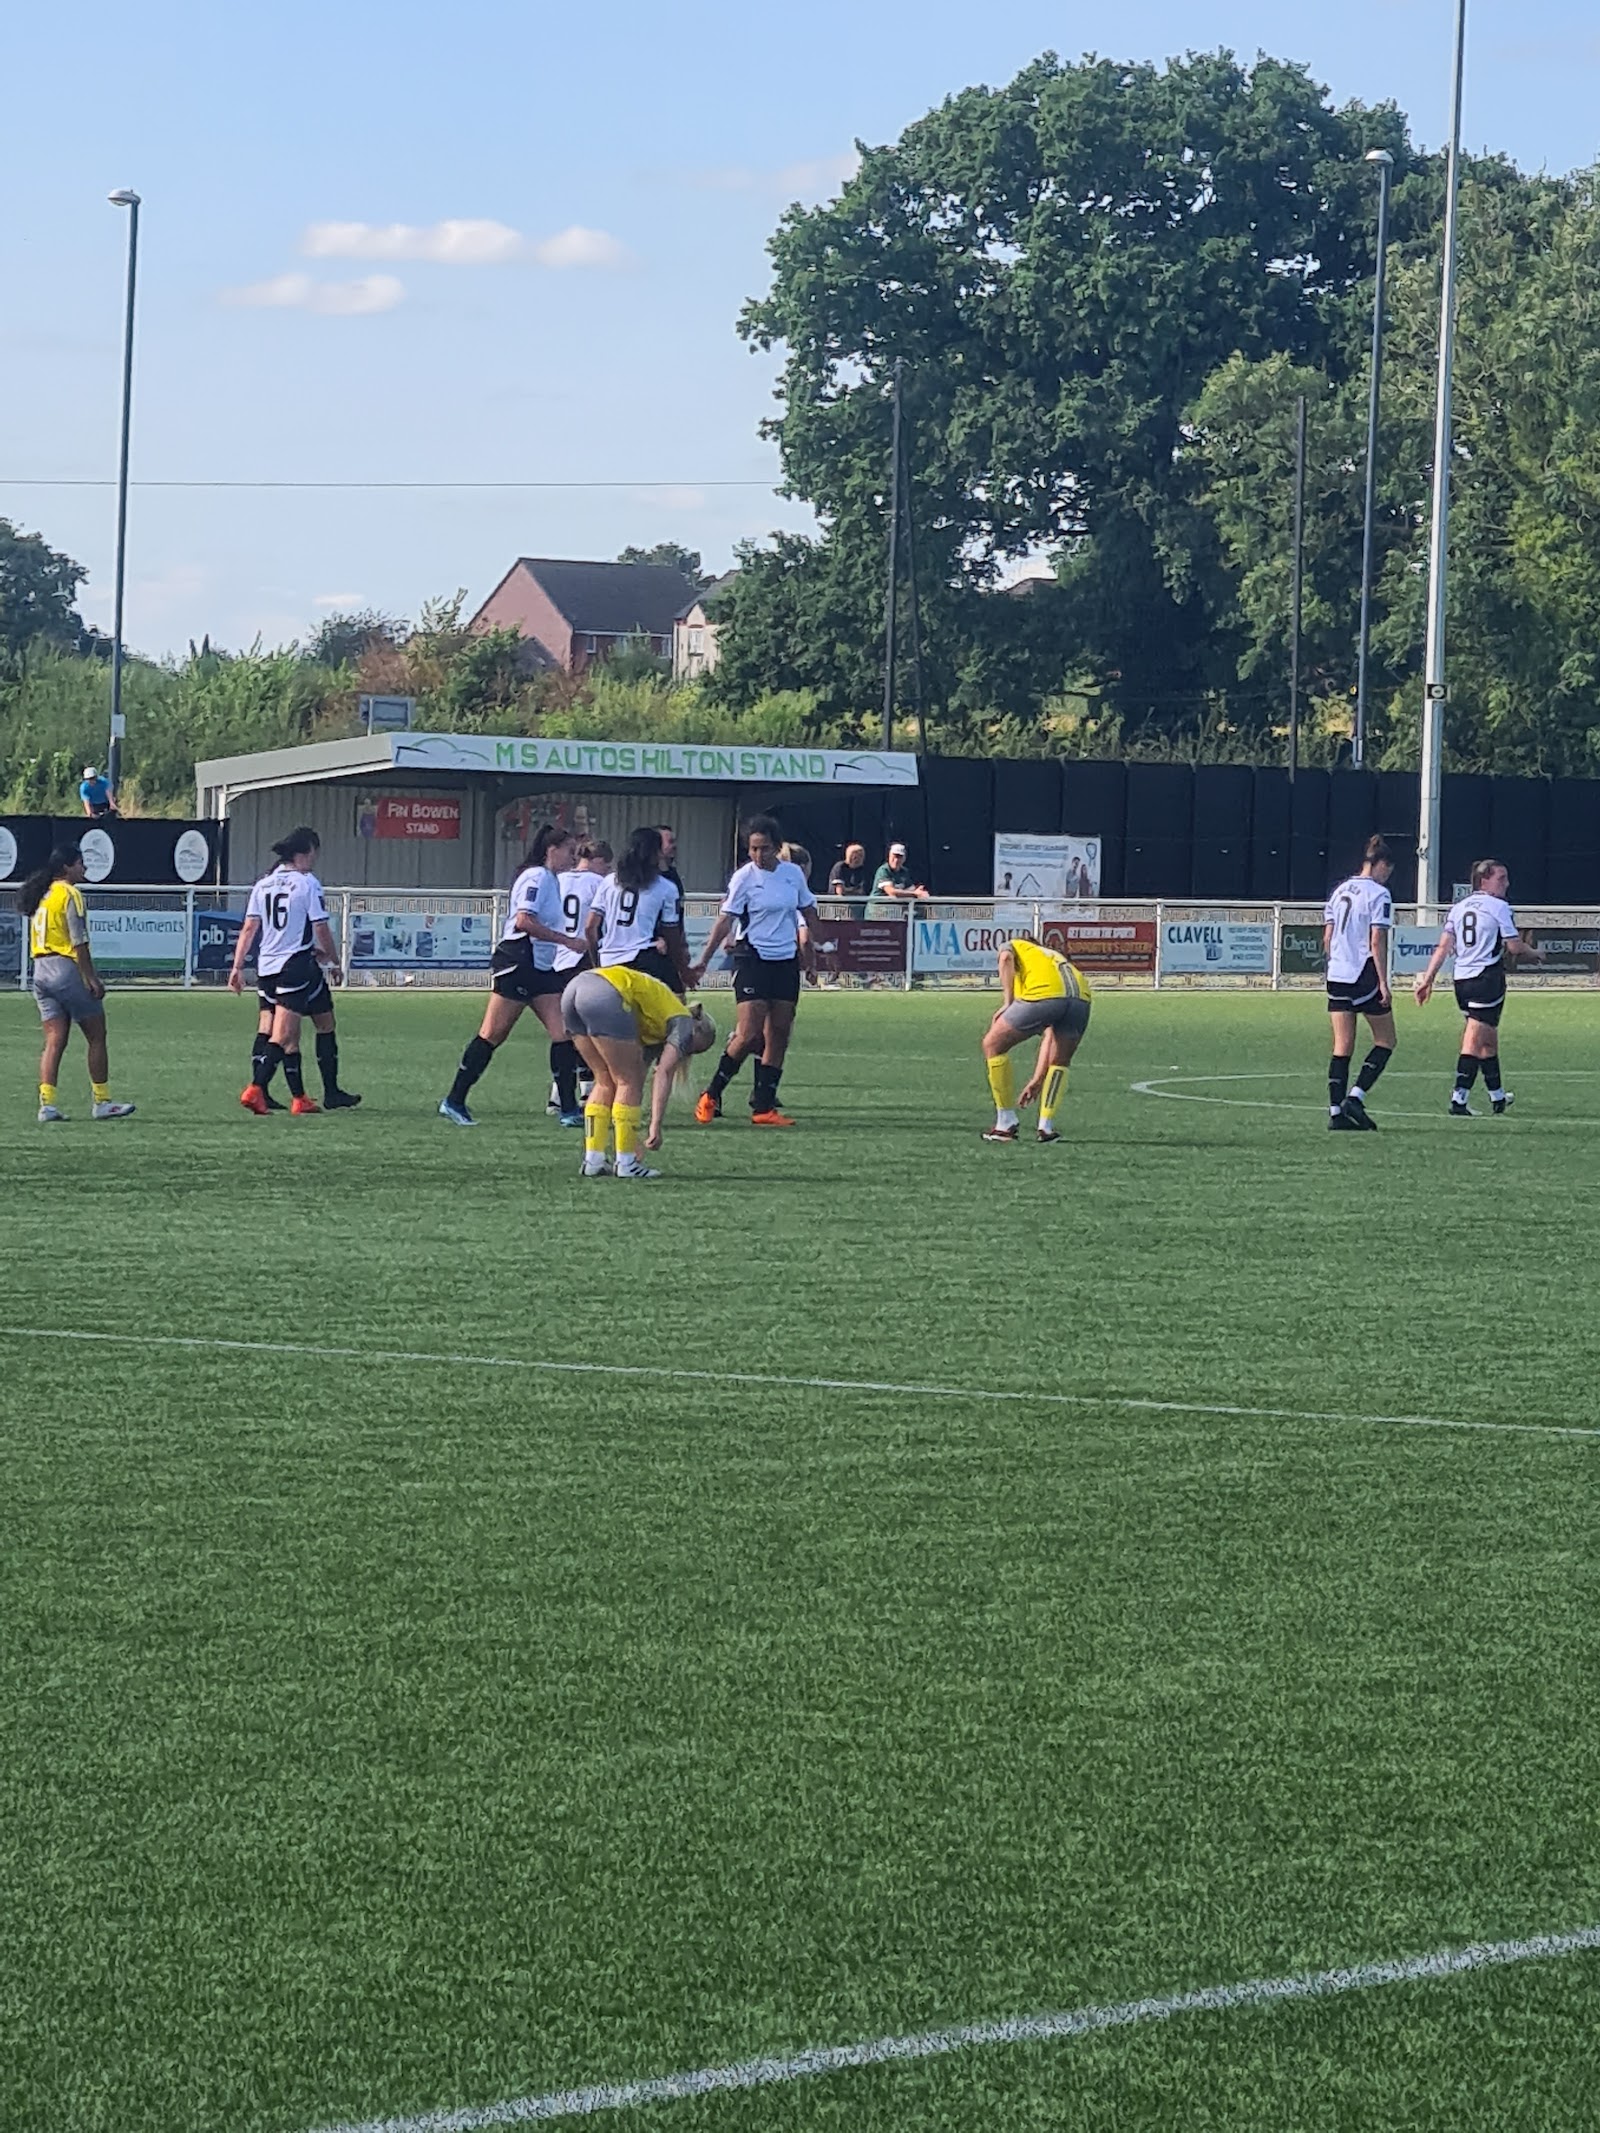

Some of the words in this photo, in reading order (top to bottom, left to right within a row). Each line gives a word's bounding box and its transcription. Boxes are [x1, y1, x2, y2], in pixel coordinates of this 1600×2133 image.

[496, 742, 515, 769] M
[521, 743, 539, 769] S
[544, 746, 636, 771] AUTOS
[641, 749, 735, 776] HILTON
[740, 752, 825, 778] STAND
[406, 822, 440, 834] STAND
[412, 803, 459, 819] BOWEN
[125, 916, 185, 933] Moments
[265, 893, 289, 931] 16
[563, 894, 580, 934] 9
[617, 887, 639, 927] 9
[1341, 896, 1353, 936] 7
[919, 923, 961, 955] MA
[1168, 926, 1223, 943] CLAVELL
[1462, 911, 1478, 948] 8
